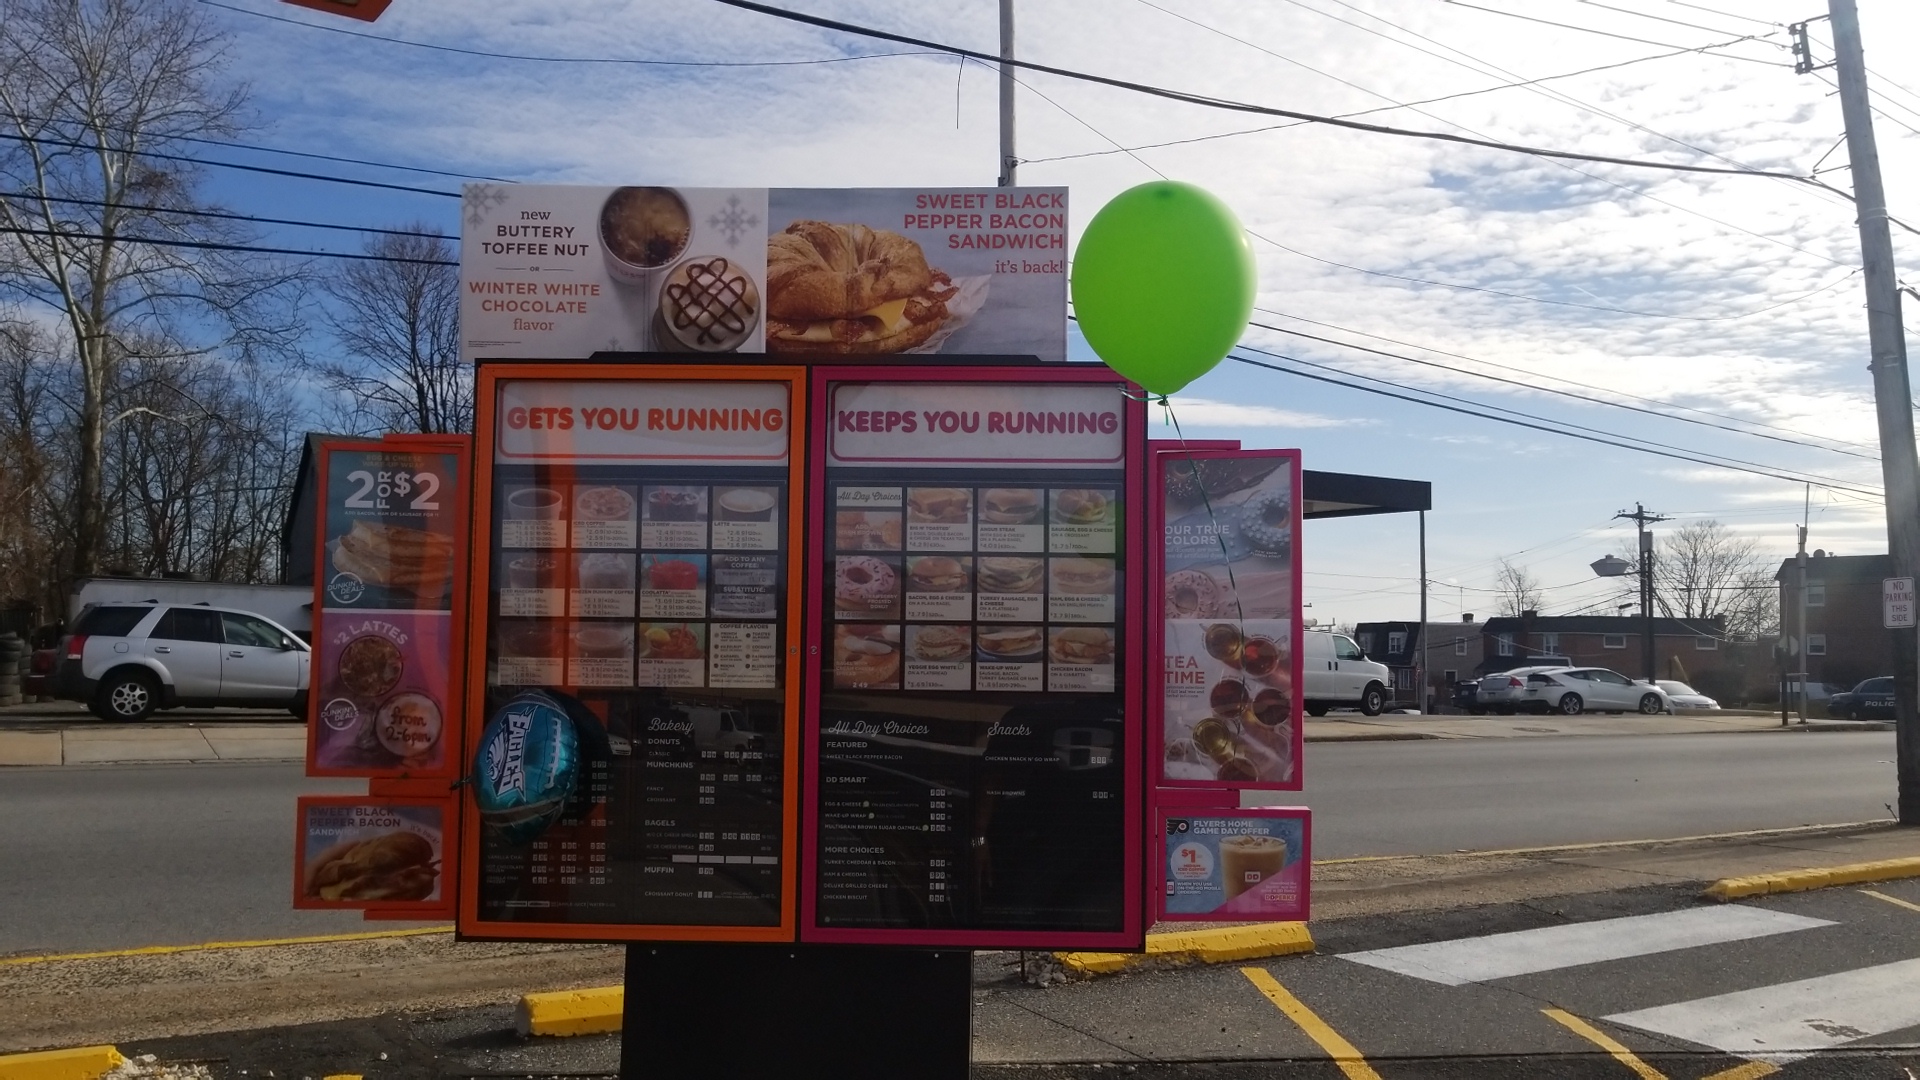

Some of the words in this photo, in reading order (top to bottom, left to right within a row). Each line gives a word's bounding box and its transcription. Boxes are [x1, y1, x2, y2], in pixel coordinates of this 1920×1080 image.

[916, 194, 988, 209] SWEET
[995, 193, 1064, 209] BLACK
[520, 210, 551, 221] new
[904, 214, 983, 229] PEPPER
[990, 214, 1063, 229] BACON
[497, 225, 575, 239] BUTTERY
[948, 234, 1063, 249] SANDWICH
[482, 242, 548, 255] TOFFEE
[554, 244, 589, 257] NUT
[995, 260, 1018, 273] it's
[1023, 260, 1063, 273] back!
[469, 282, 538, 295] WINTER
[545, 283, 600, 296] WHITE
[481, 300, 587, 313] CHOCOLATE
[513, 319, 555, 331] flavor
[507, 407, 574, 430] GETS
[581, 408, 639, 431] YOU
[648, 408, 783, 431] RUNNING
[838, 410, 917, 433] KEEPS
[923, 411, 980, 433] YOU
[988, 411, 1118, 434] RUNNING
[344, 470, 374, 508] 2
[376, 471, 392, 509] FOR
[393, 471, 440, 510] $2
[837, 491, 851, 501] All
[851, 490, 871, 503] Day
[871, 491, 902, 501] Choices
[1164, 525, 1192, 535] OUR
[1195, 525, 1230, 535] TRUE
[1164, 536, 1217, 545] COLORS
[340, 584, 366, 595] DEALS
[1893, 580, 1905, 591] NO
[1885, 592, 1913, 602] PARKING
[1891, 604, 1908, 613] THIS
[1891, 614, 1908, 622] SIDE
[349, 620, 409, 645] LATTES
[1165, 656, 1198, 669] TEA
[1164, 671, 1205, 684] TIME
[390, 706, 427, 727] from
[648, 717, 694, 735] Bakery
[827, 720, 850, 735] All
[851, 720, 882, 738] Day
[883, 720, 930, 735] Choices
[986, 721, 1032, 738] Snacks
[646, 761, 694, 769] MUNCHKINS
[309, 807, 350, 817] SWEET
[355, 807, 395, 817] BLACK
[309, 817, 355, 827] PEPPER
[359, 818, 401, 827] BACON
[644, 819, 676, 827] BAGELS
[309, 828, 360, 836] SANDWICH
[1193, 827, 1220, 835] GAME
[824, 846, 848, 854] MORE
[1181, 848, 1196, 863] $1
[644, 866, 675, 874] MUFFIN
